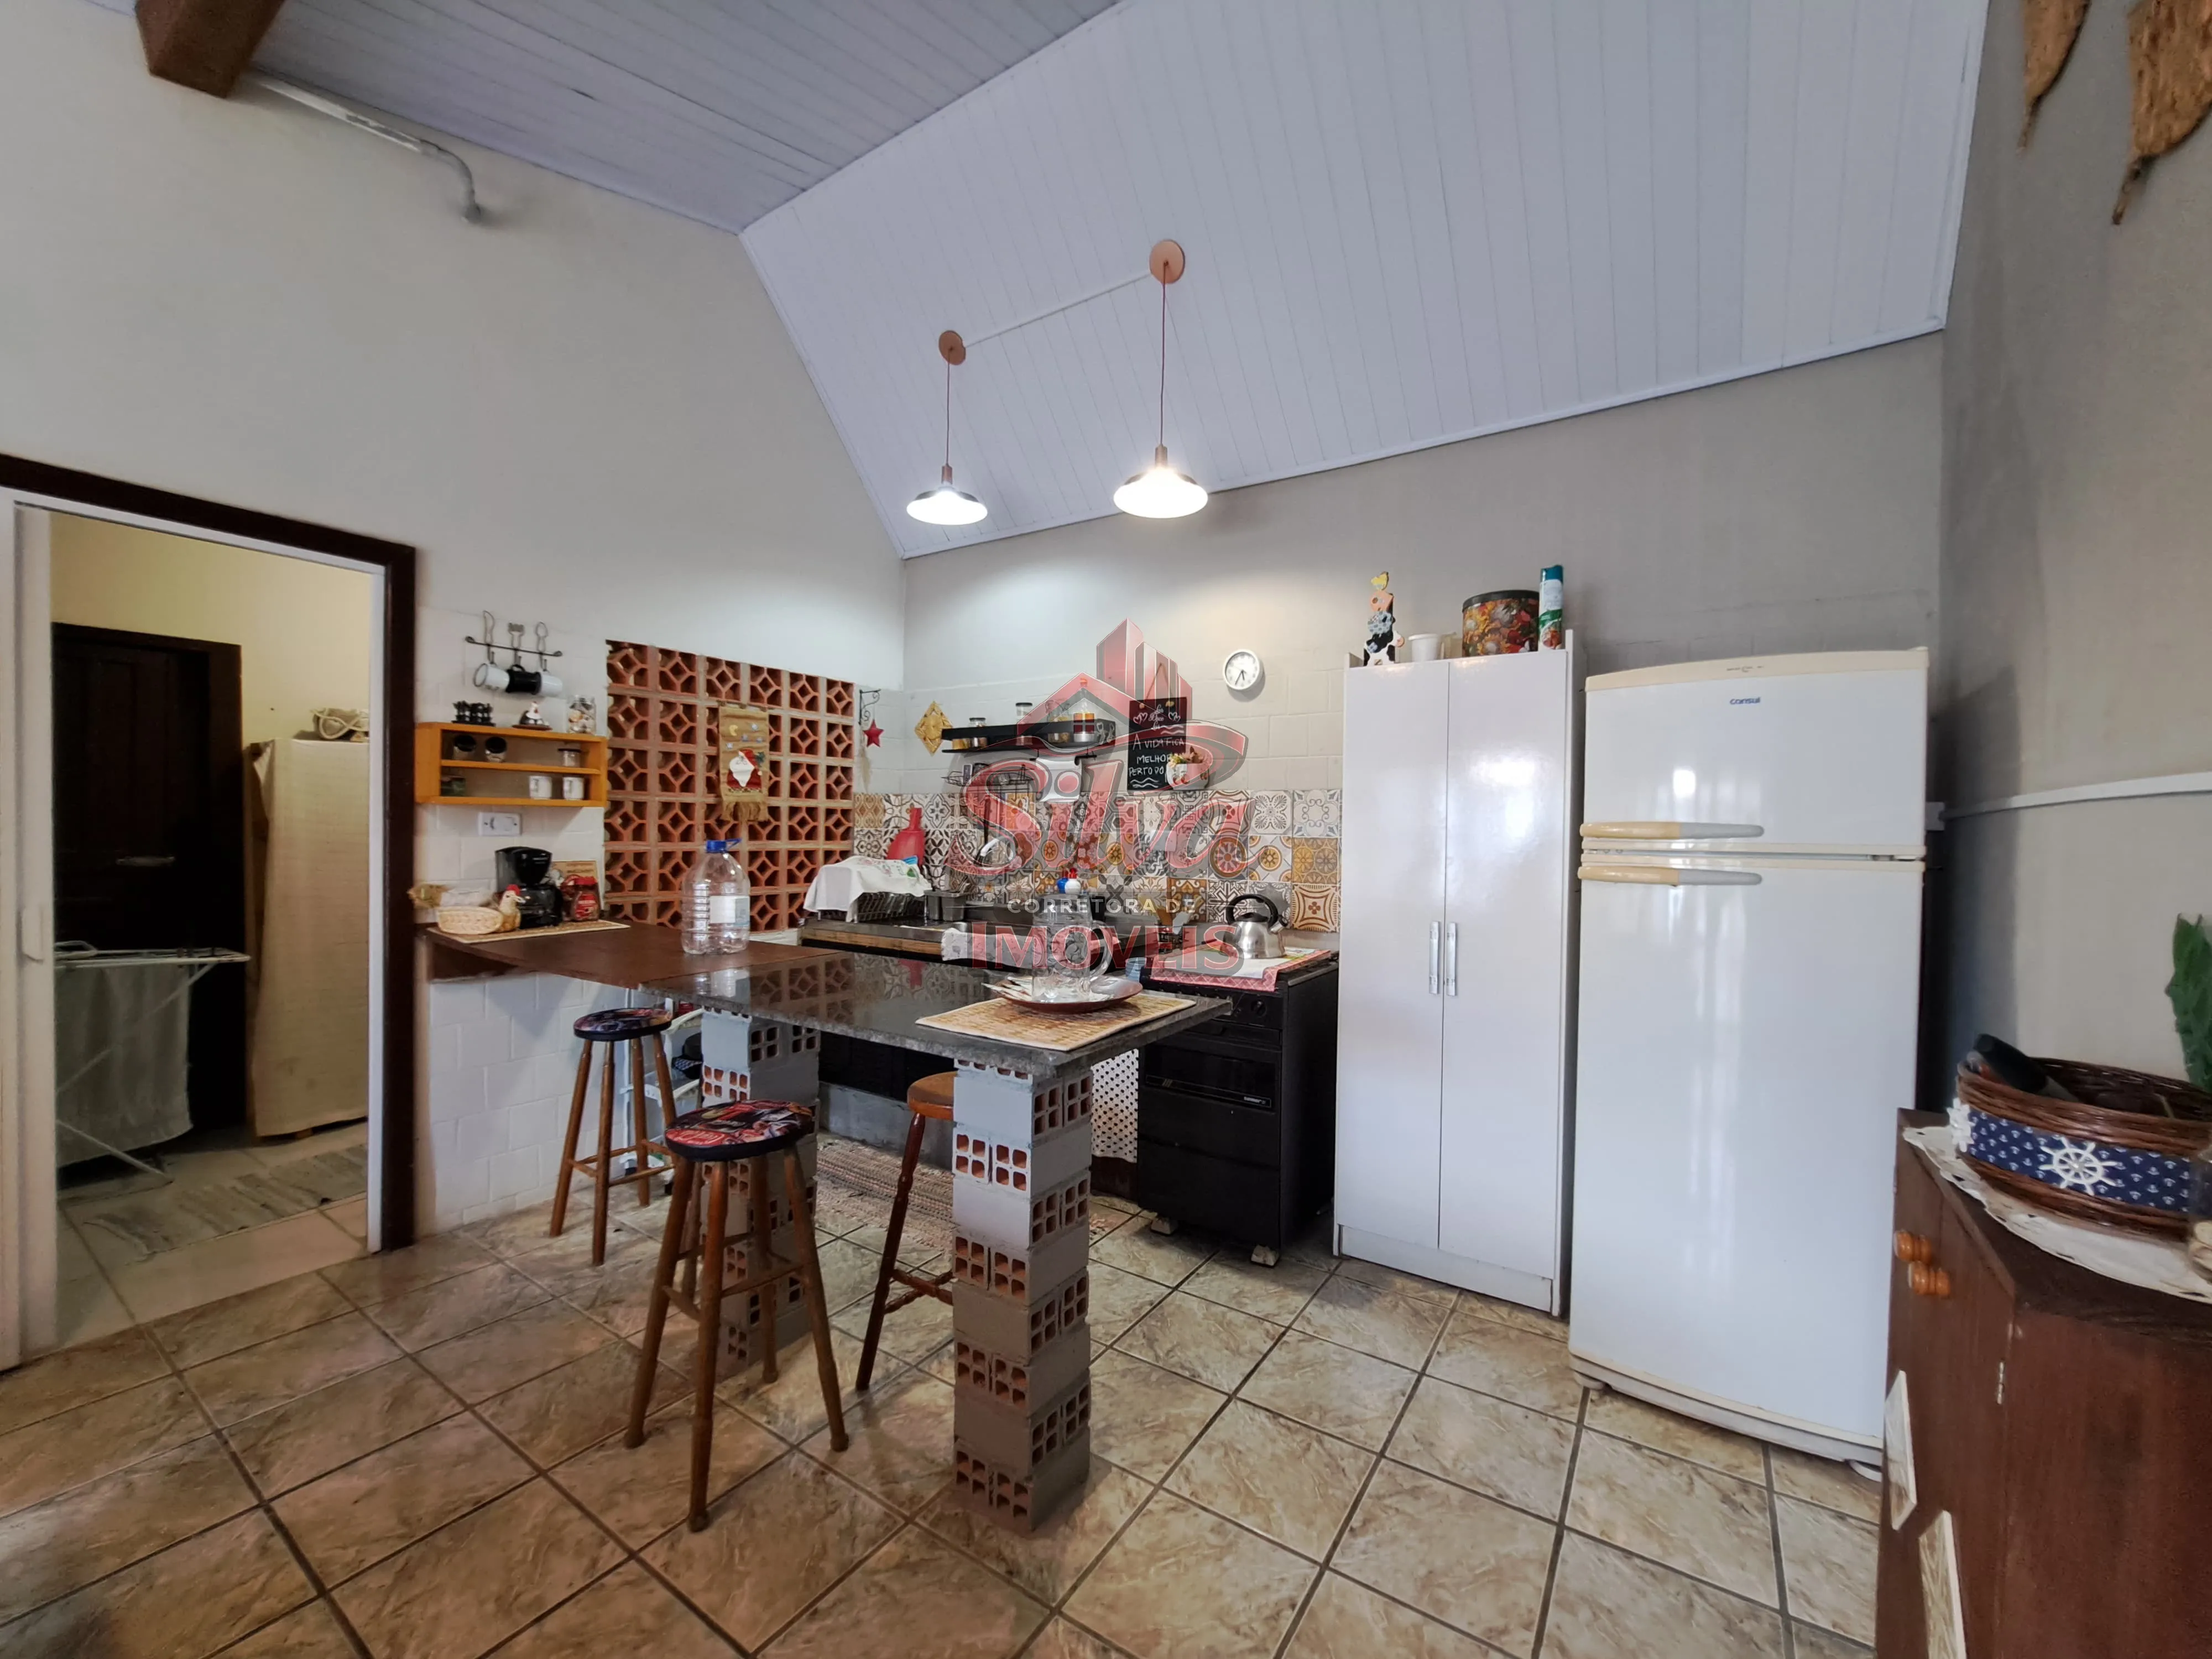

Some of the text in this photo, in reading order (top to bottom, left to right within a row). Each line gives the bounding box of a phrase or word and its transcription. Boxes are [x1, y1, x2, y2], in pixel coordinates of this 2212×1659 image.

[1133, 733, 1185, 750] A VIDA FICA
[1129, 766, 1164, 778] PERTO DO
